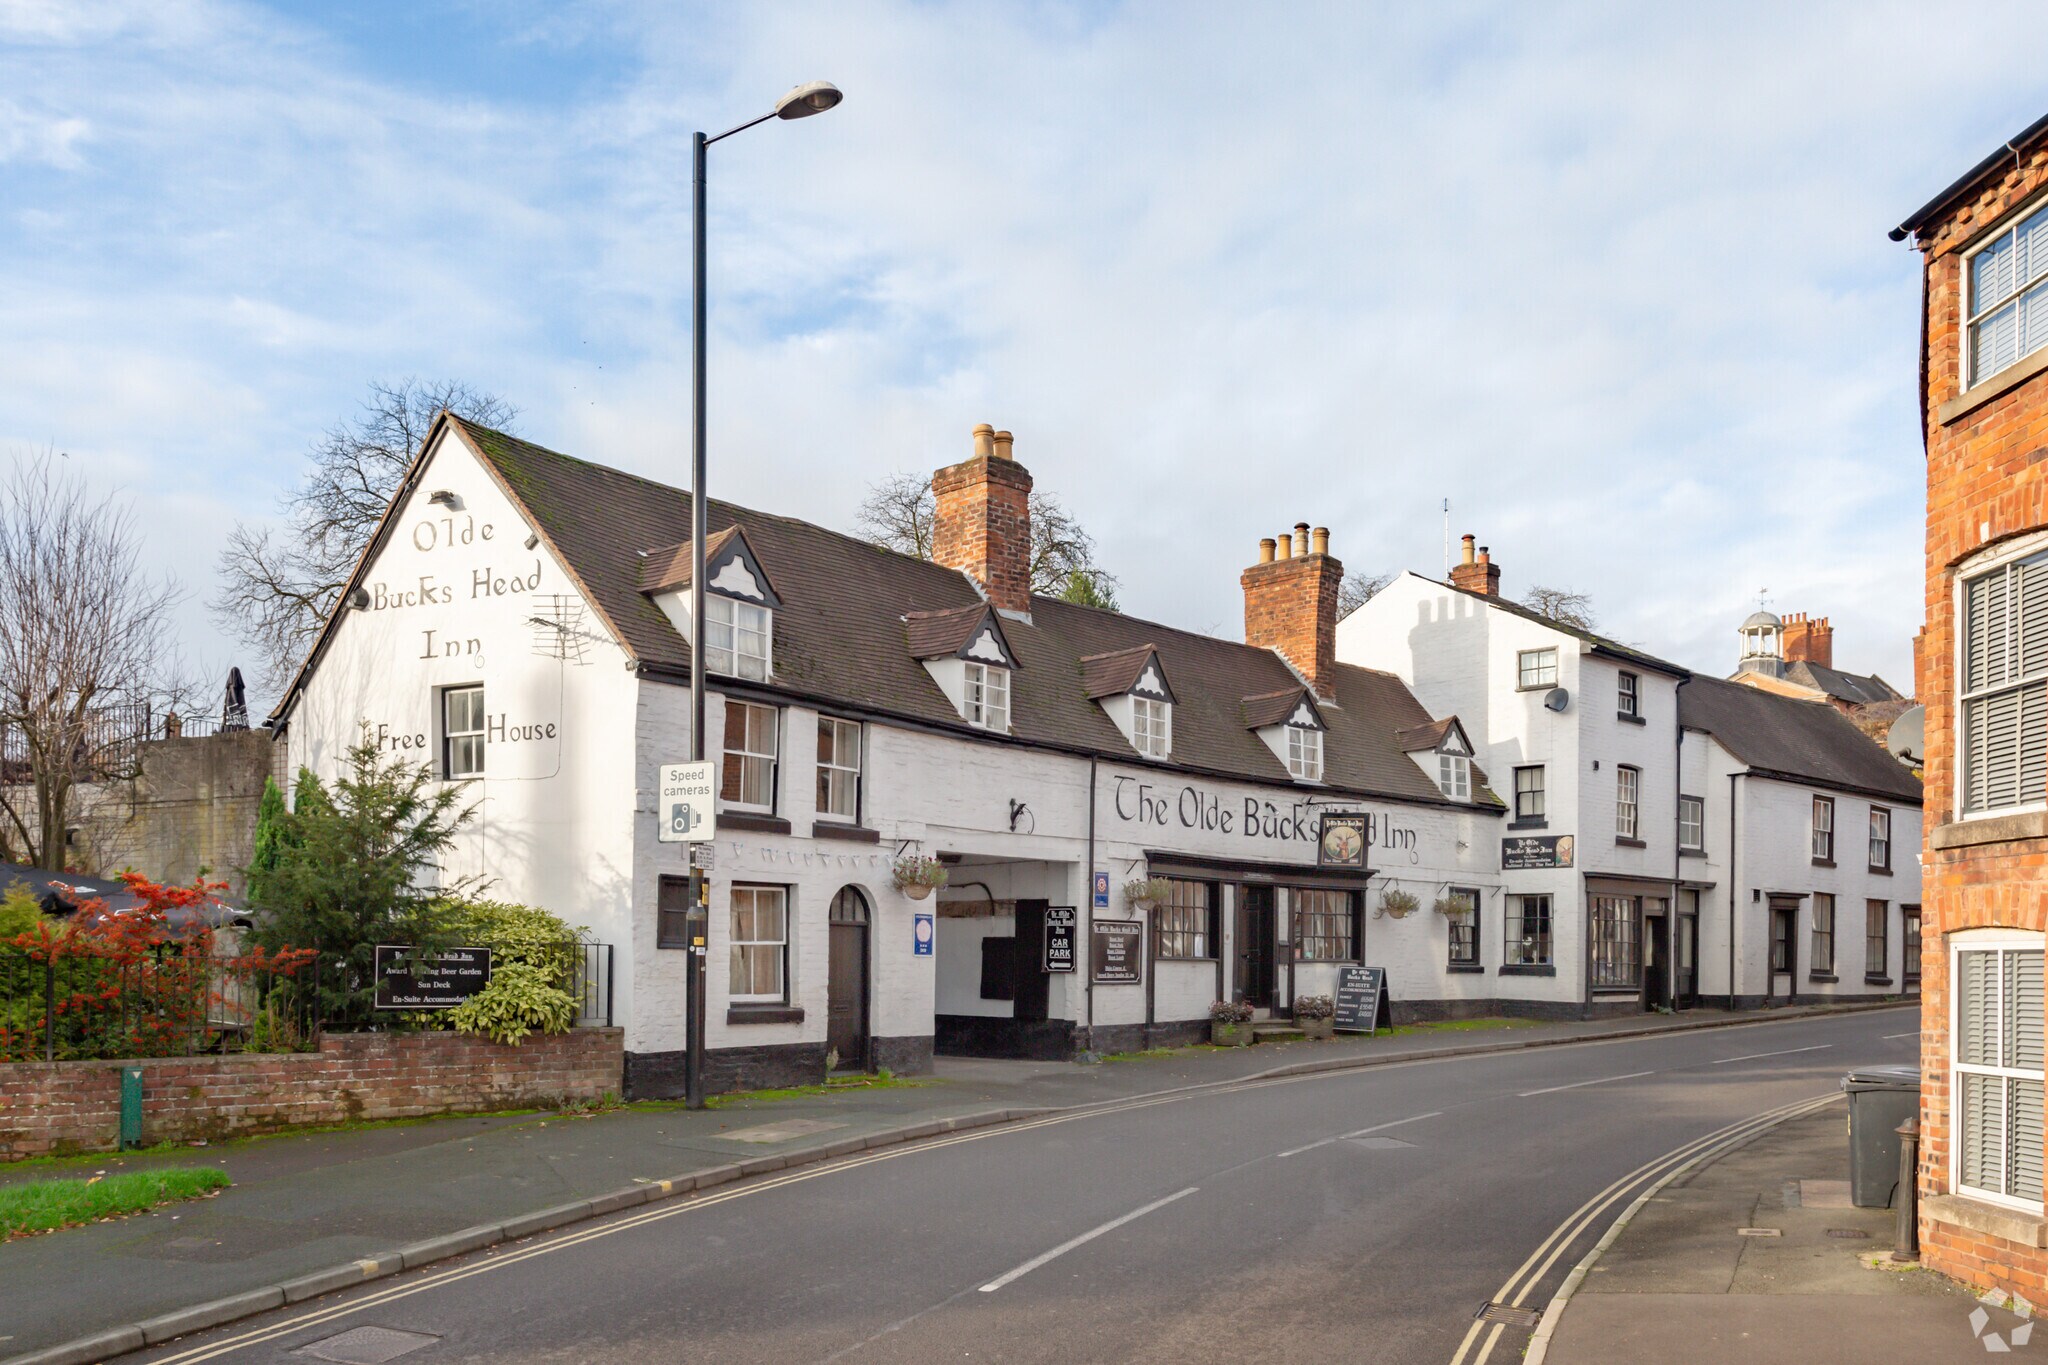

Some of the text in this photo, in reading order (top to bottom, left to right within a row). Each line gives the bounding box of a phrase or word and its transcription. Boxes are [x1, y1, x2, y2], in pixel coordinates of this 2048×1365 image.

[413, 516, 494, 551] Olde
[373, 559, 542, 610] Bucks Head
[419, 630, 485, 668] Inn
[377, 713, 556, 751] Free House
[670, 769, 704, 782] Speed
[664, 786, 710, 796] cameras
[1114, 775, 1168, 825] The
[1178, 786, 1233, 834] Olde
[1244, 797, 1319, 842] Bucks
[1384, 813, 1419, 865] Inn
[1525, 847, 1540, 855] Head
[1052, 939, 1068, 947] CAR
[1050, 949, 1070, 958] PARK
[411, 968, 439, 976] Wning
